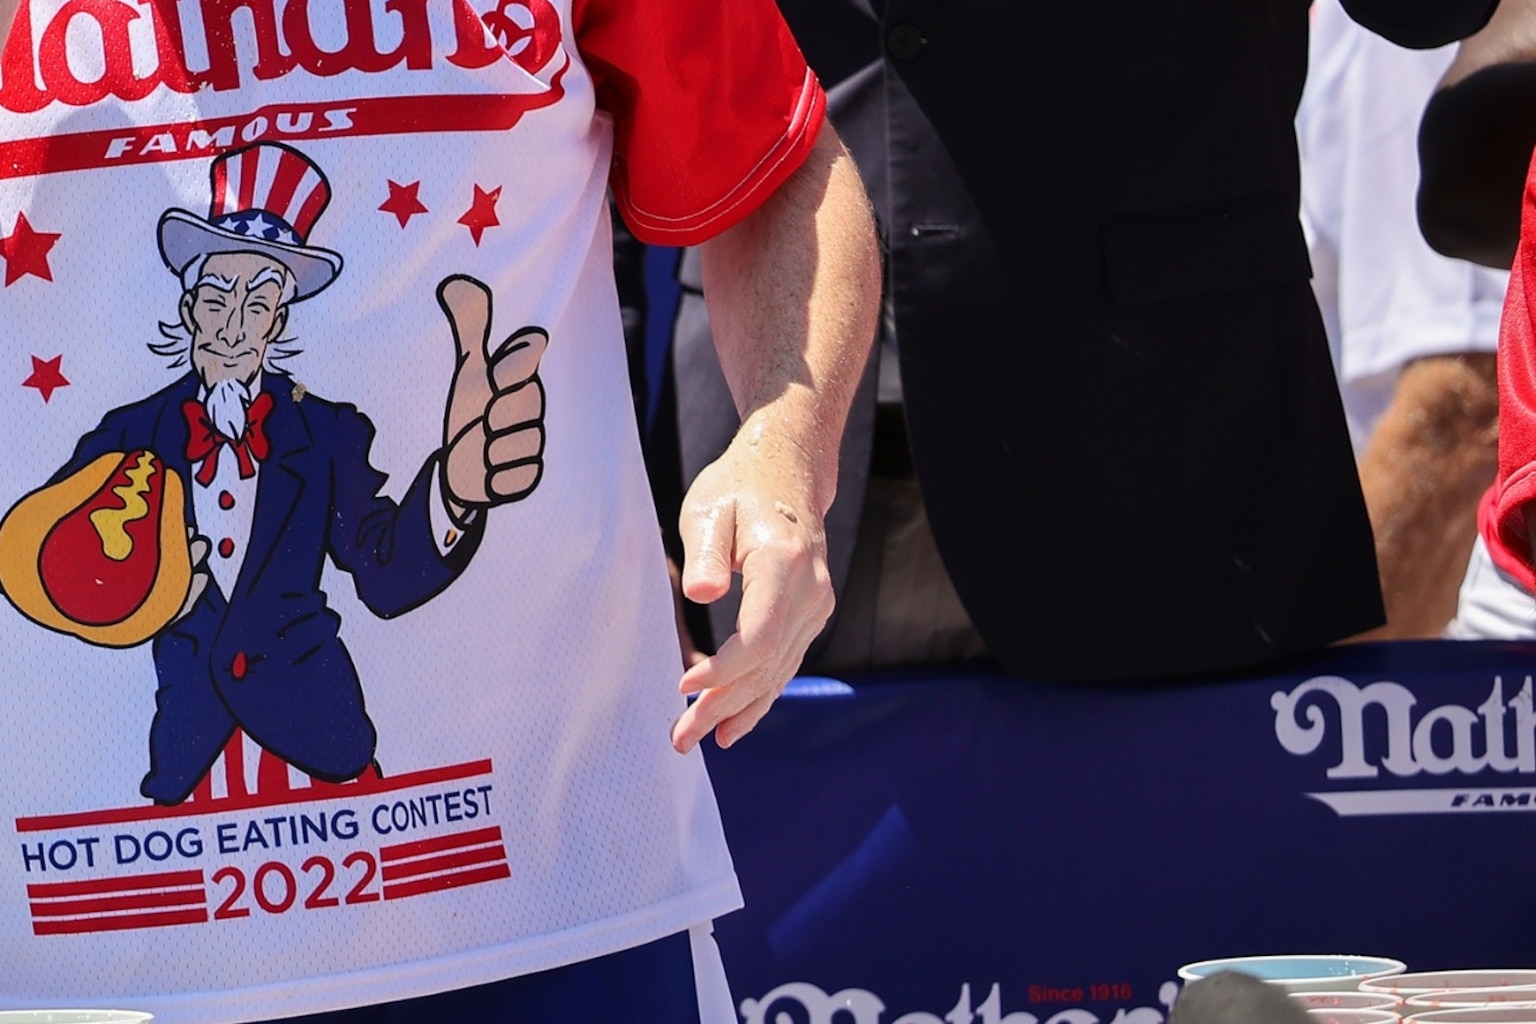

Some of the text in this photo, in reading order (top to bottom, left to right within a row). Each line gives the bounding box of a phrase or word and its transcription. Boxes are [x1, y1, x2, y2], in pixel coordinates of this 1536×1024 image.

[104, 107, 357, 159] FAMOUS
[1450, 792, 1536, 808] FAM
[22, 785, 492, 872] HOT DOG EATING CONTEST
[211, 851, 380, 920] 2022
[1027, 983, 1083, 1004] Since
[1089, 983, 1132, 1002] 1916
